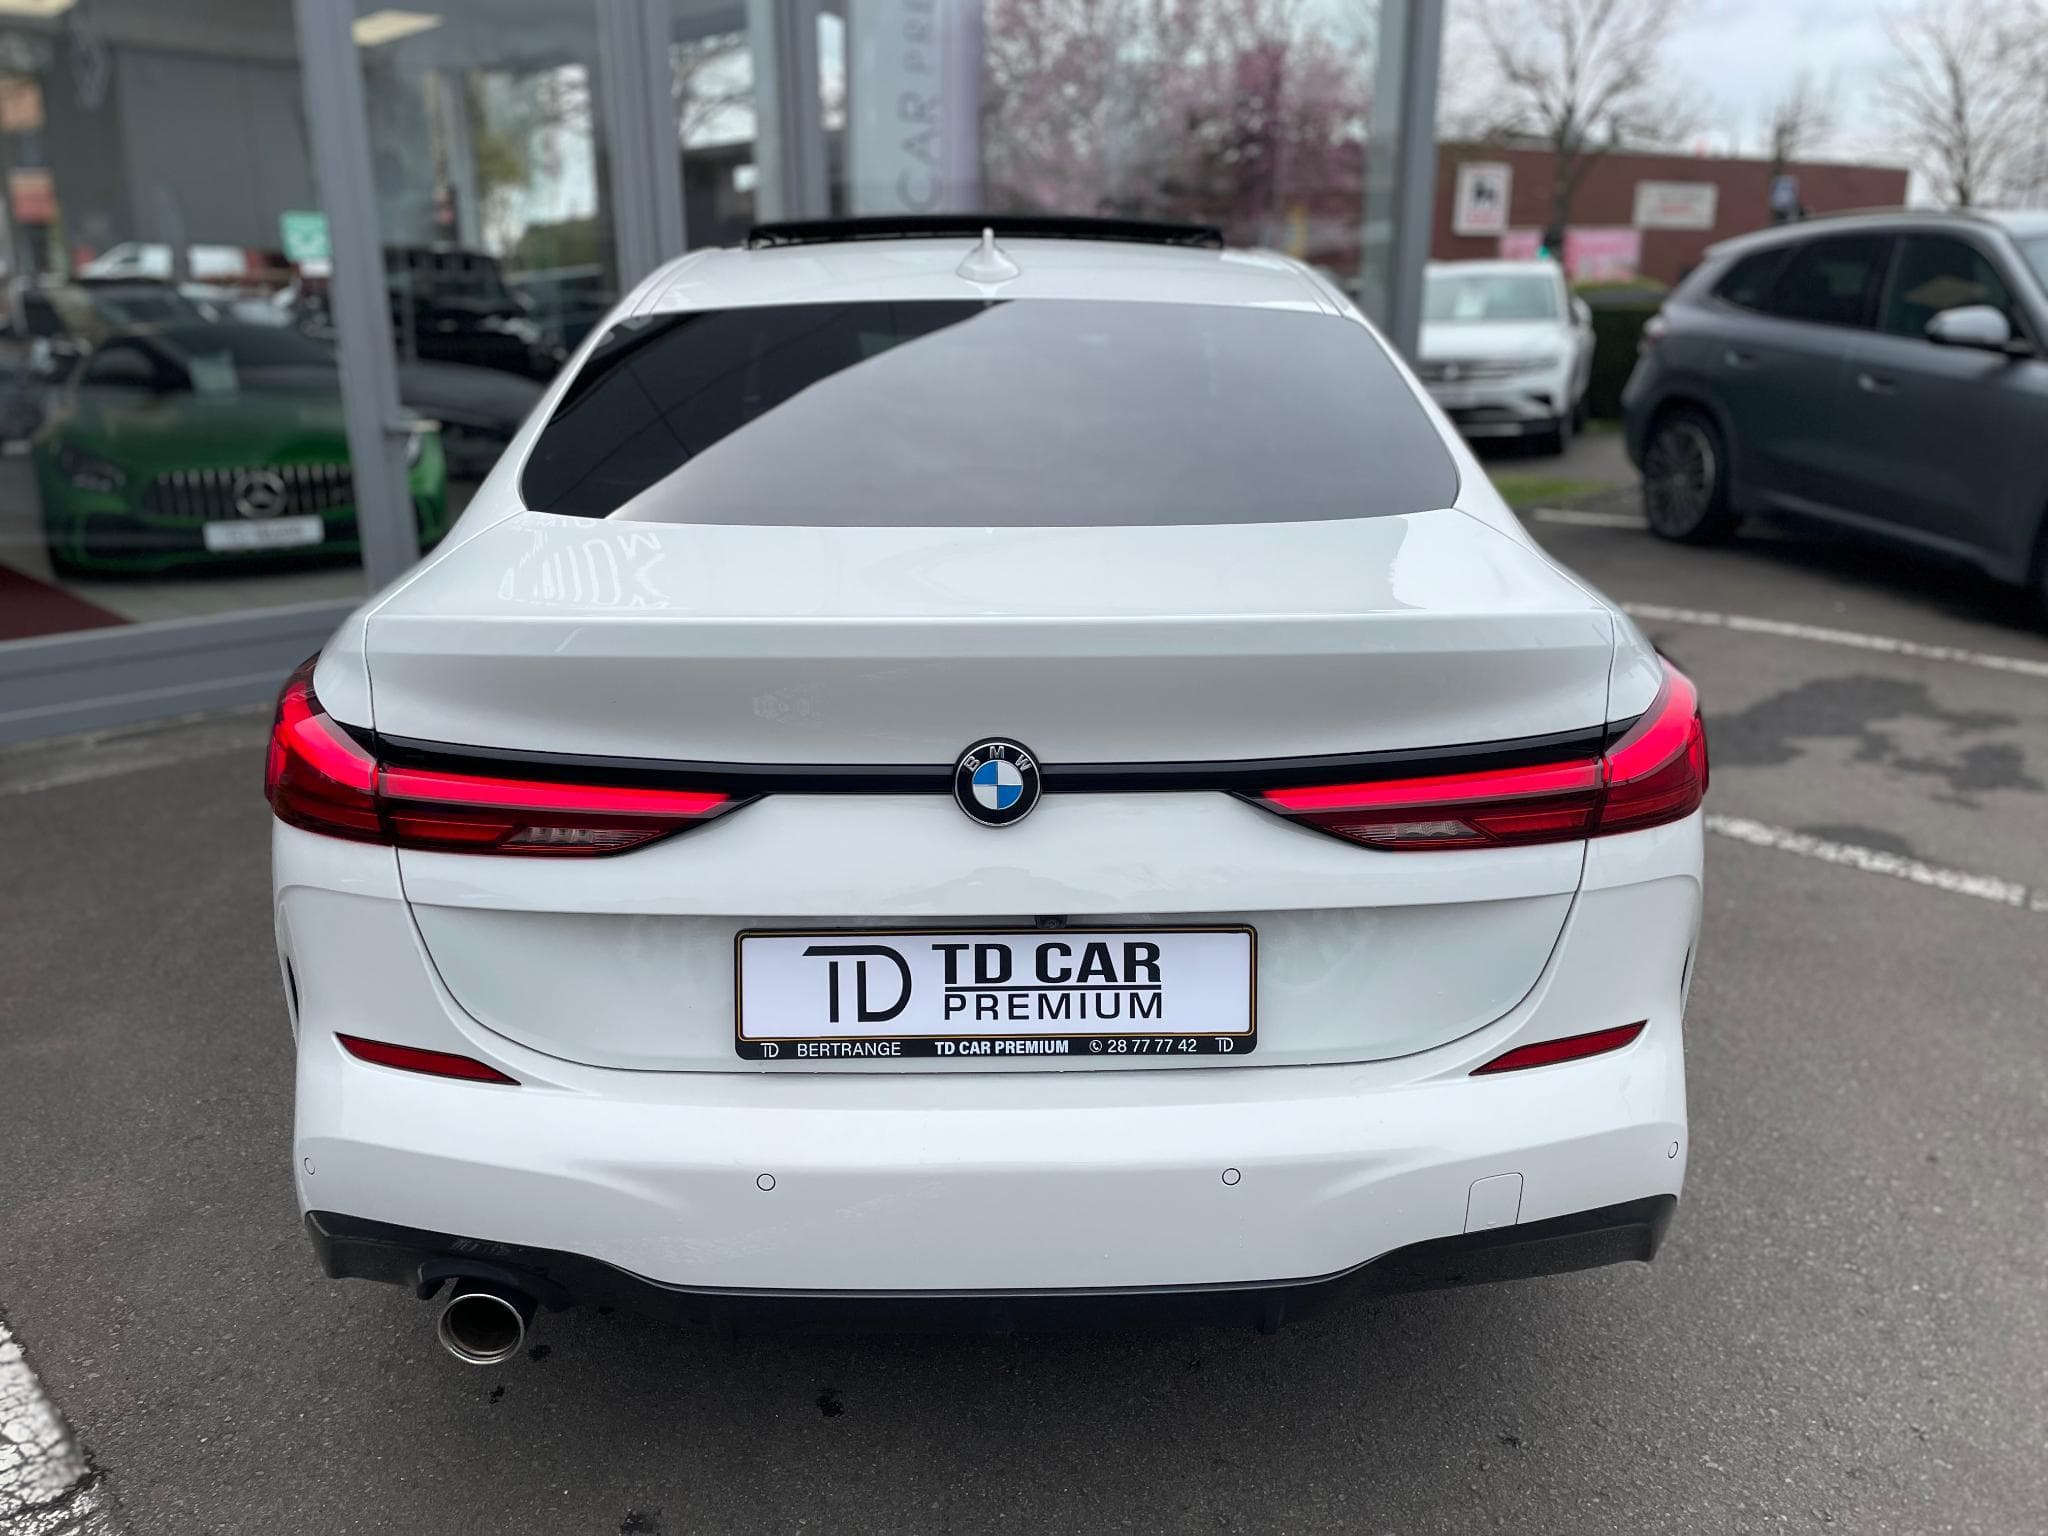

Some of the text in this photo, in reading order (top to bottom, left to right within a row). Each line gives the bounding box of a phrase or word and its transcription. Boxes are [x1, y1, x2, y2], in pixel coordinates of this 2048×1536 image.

[896, 91, 942, 213] CAR
[963, 745, 1032, 773] BMW
[931, 942, 1162, 985] TD CAR
[802, 944, 912, 1023] TD
[943, 992, 1163, 1021] PREMIUM
[760, 1037, 1234, 1058] TD BERTRANGE TD CAR PREMIUM 28 77 77 42 TD
